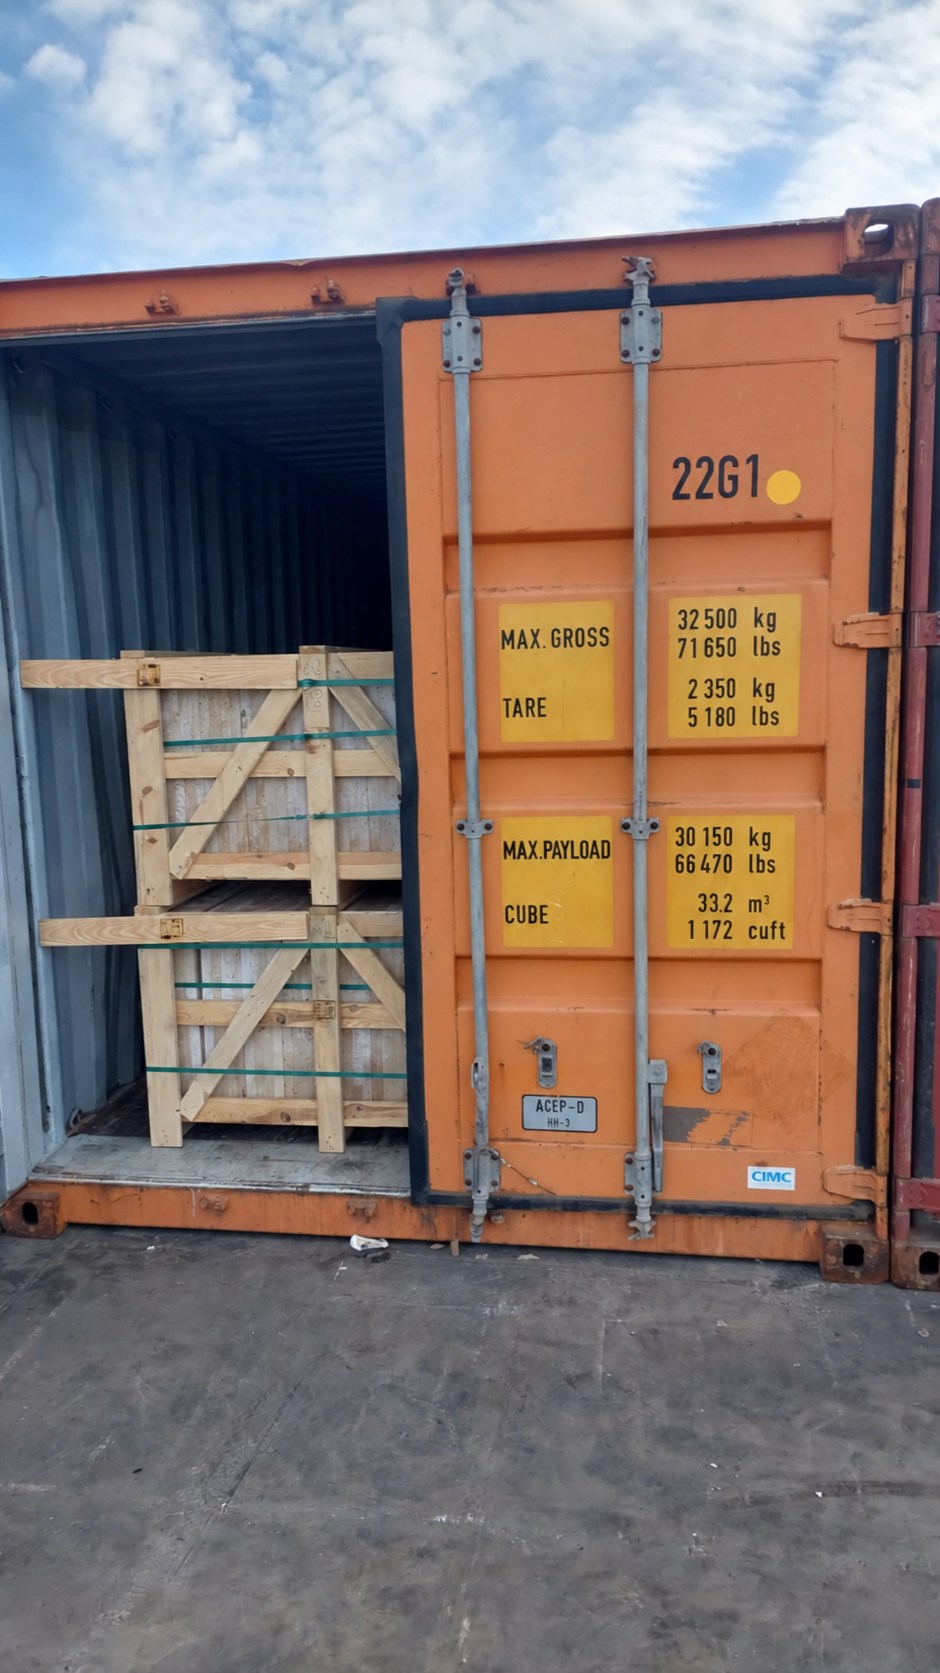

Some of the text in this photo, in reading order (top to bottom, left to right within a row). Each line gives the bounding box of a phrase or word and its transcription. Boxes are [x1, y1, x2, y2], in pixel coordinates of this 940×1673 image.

[672, 454, 759, 500] 22G1
[753, 607, 777, 633] kg
[501, 627, 610, 650] MAX. GROSS
[753, 636, 781, 657] lbs
[752, 677, 776, 703] kg
[502, 697, 547, 719] TARE
[751, 706, 780, 727] lbs
[749, 826, 772, 852] kg
[749, 853, 776, 874] lbs
[697, 893, 733, 913] 33.2
[504, 904, 549, 924] CUBE
[748, 920, 786, 940] cuft
[535, 1098, 585, 1114] ACEP-D
[547, 1118, 570, 1128] HH-3
[751, 1170, 792, 1183] CIMC
